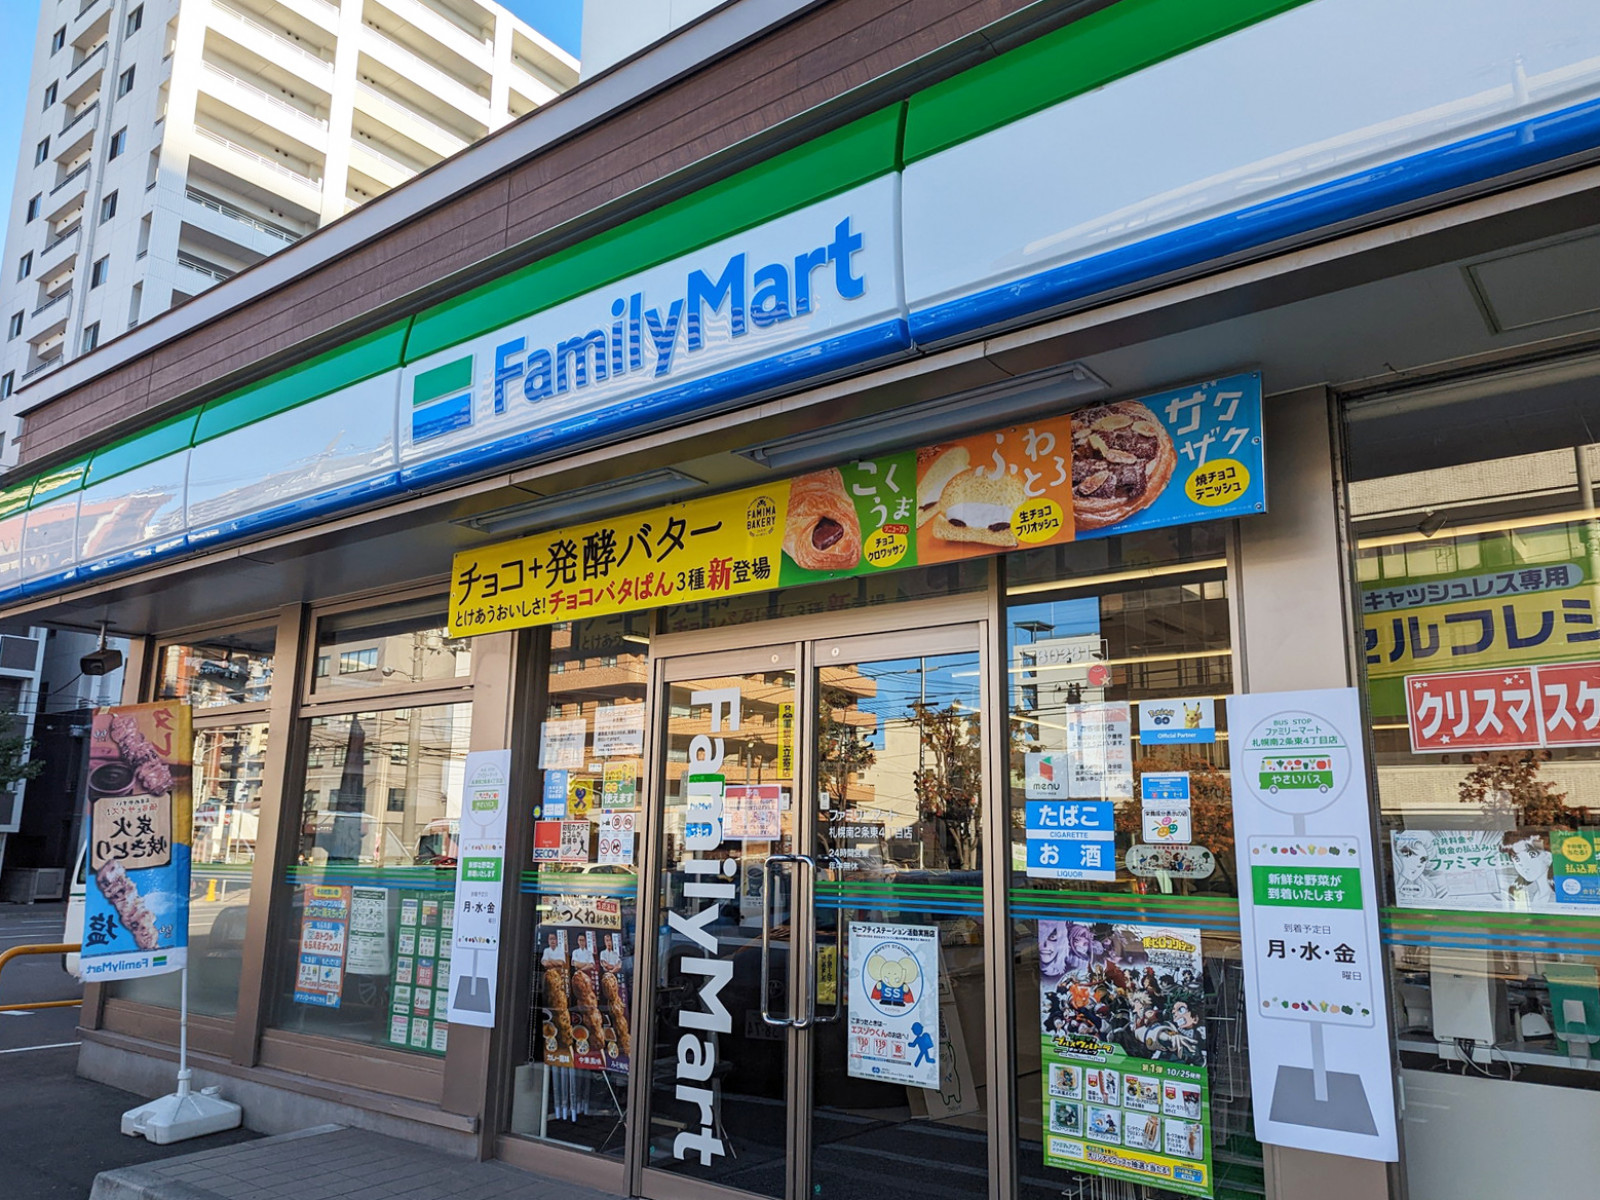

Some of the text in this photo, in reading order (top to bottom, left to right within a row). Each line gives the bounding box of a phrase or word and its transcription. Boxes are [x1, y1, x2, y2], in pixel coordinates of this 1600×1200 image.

[494, 215, 865, 416] FamilyMart
[976, 428, 1057, 481] ふわ
[1179, 426, 1250, 468] ザク
[851, 461, 901, 497] こく
[1022, 455, 1068, 497] とろ
[1195, 467, 1237, 488] 焼チョコ
[1194, 481, 1243, 501] デニッシュ
[747, 505, 776, 520] FAMIMA
[869, 496, 914, 528] うま
[1018, 504, 1053, 524] 生チョコ
[747, 516, 776, 530] BAKERY
[875, 534, 895, 548] チョコ
[867, 543, 906, 562] クロワッサン
[458, 516, 722, 606] チョコ+発酵バター
[1364, 565, 1570, 610] キャッシュレス専用
[1154, 716, 1170, 726] GO
[1416, 688, 1532, 740] クリスマ
[1157, 731, 1197, 740] Official Partner
[1266, 726, 1322, 737] ファミリーマート
[1252, 736, 1338, 747] 札幌南2条東4丁目店
[1033, 782, 1060, 791] menu
[1271, 774, 1322, 785] やさいバス
[604, 793, 634, 804] 使えます
[1039, 804, 1100, 827] たばこ
[1050, 831, 1089, 839] CIGARETTE
[534, 849, 559, 858] SECOM
[828, 848, 870, 858] 24時間営業
[1268, 873, 1343, 888] 新鮮な野菜が
[1267, 887, 1346, 902] 到着いたします
[561, 908, 597, 925] つくね
[668, 686, 741, 1167] FamilyMart
[1283, 923, 1332, 935] 到着予定日
[1341, 970, 1362, 981] 曜日
[884, 988, 901, 999] SS
